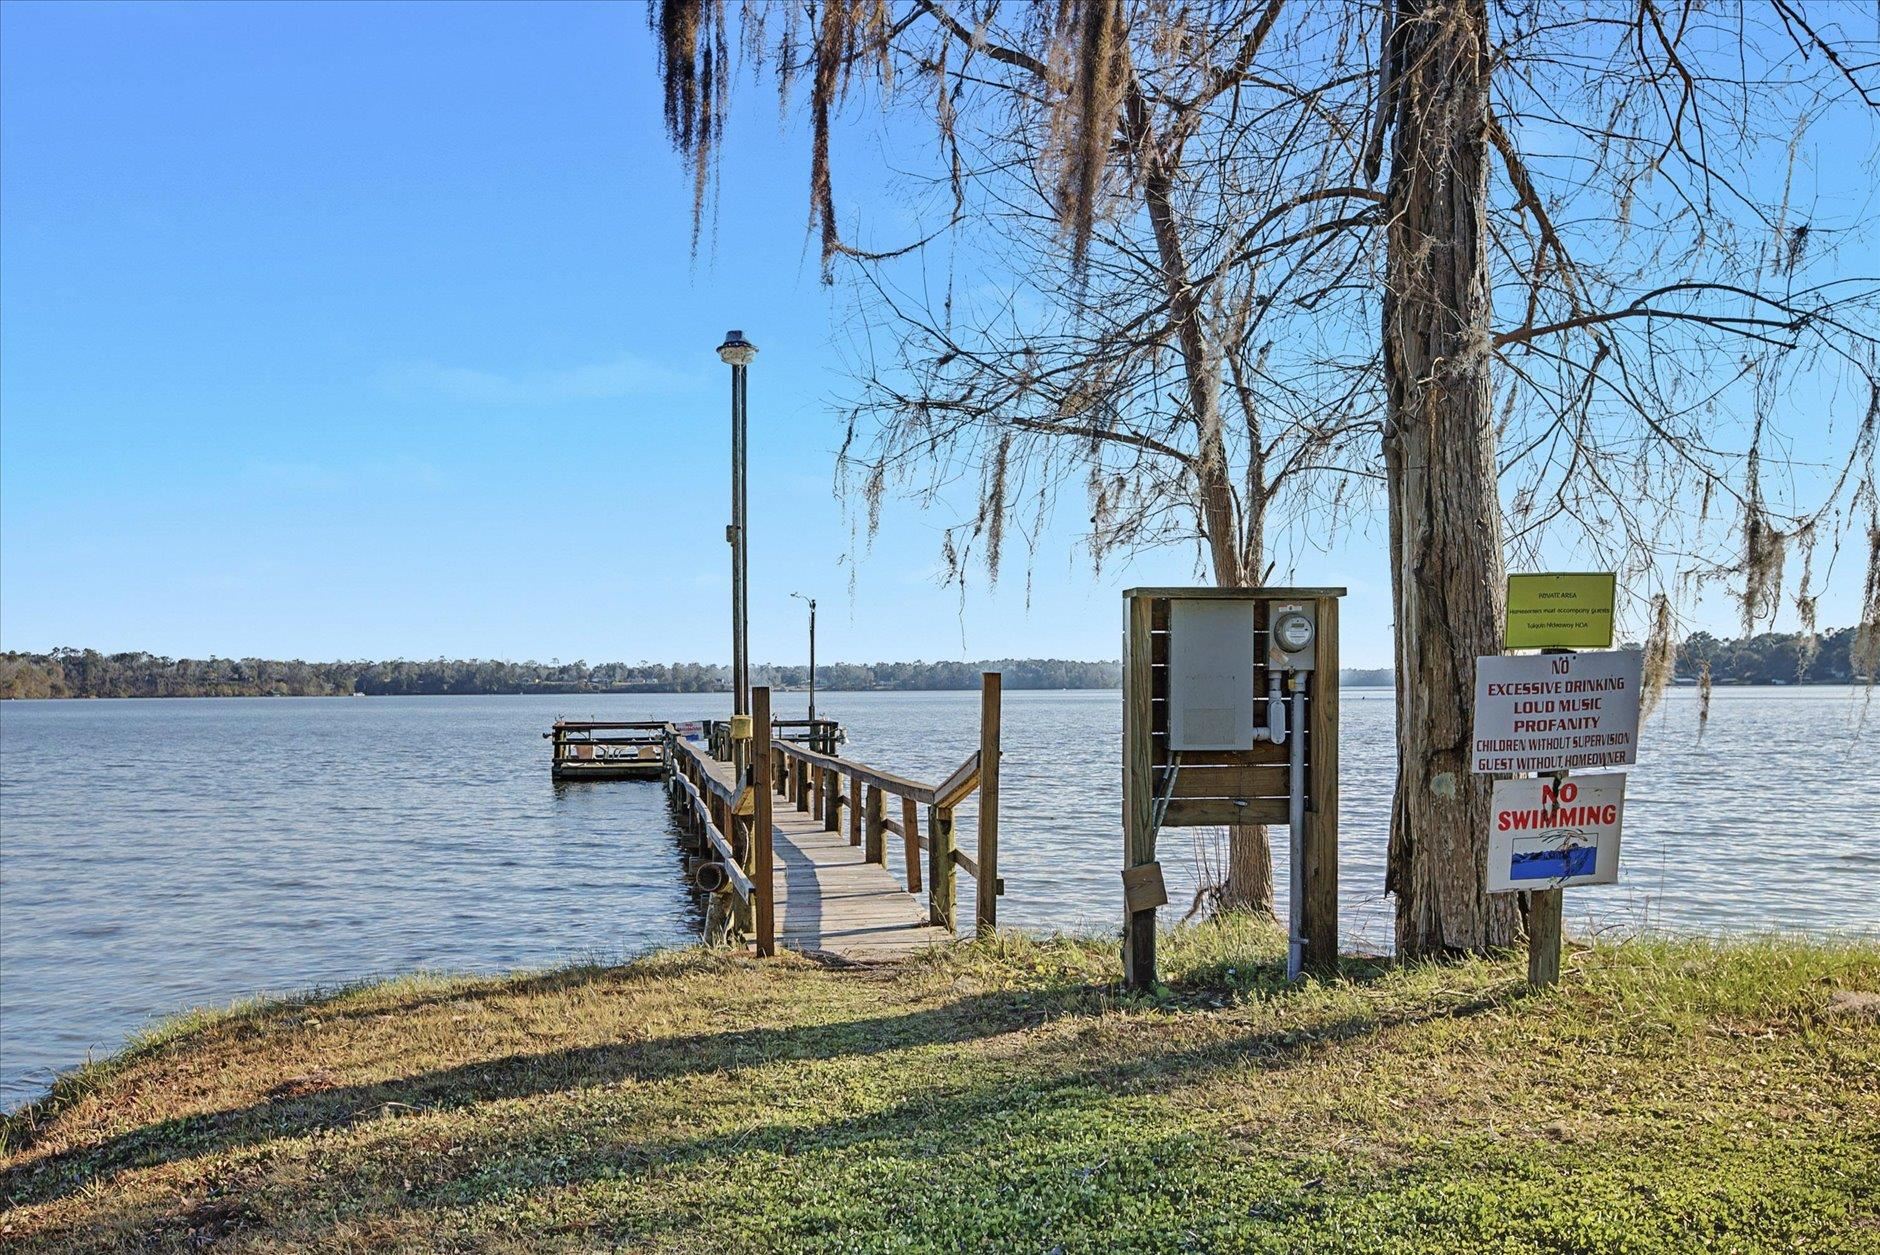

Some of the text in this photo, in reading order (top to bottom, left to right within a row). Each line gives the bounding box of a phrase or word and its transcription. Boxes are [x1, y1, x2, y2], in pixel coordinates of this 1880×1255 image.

[1551, 659, 1569, 674] NO
[1488, 677, 1625, 696] EXCESSIVE DRINKING
[1514, 698, 1602, 714] LOUD MUSIC
[1514, 716, 1600, 733] PROFANITY
[1477, 733, 1630, 752] CHILDREN WITHOUT SUPERVISION
[1478, 751, 1626, 770] GUEST WITHOUT HOMEOWNER
[1542, 783, 1577, 804] NO
[1498, 804, 1616, 831] SWIMMING
